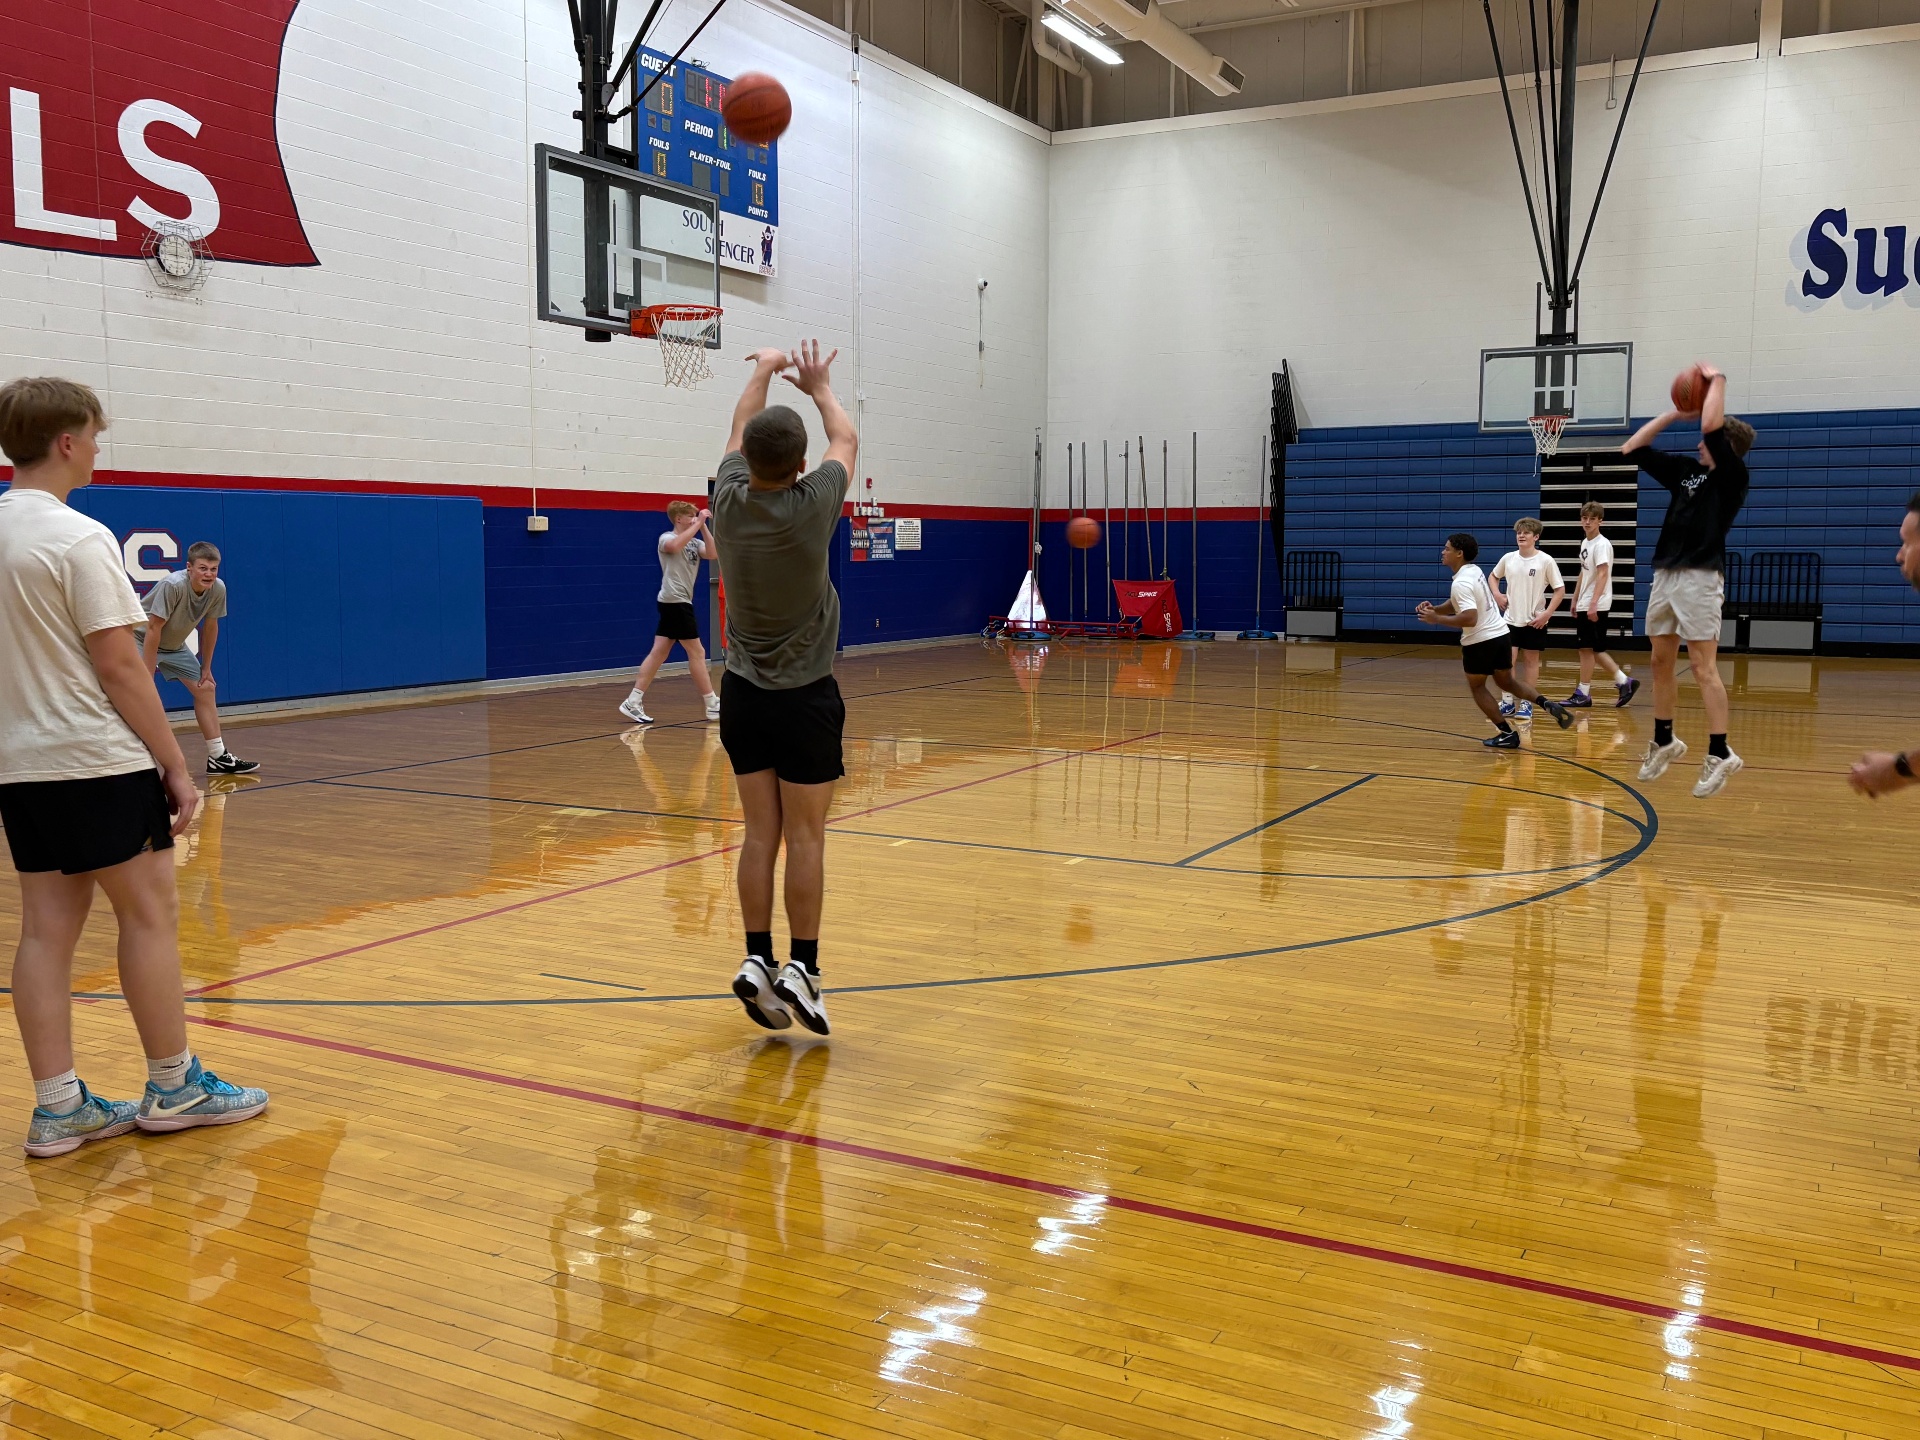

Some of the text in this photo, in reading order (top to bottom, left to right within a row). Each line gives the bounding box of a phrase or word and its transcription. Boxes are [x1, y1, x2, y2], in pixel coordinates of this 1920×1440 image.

[641, 54, 677, 77] GUEST
[685, 120, 714, 139] PERIOD
[649, 137, 670, 151] FOULS
[689, 150, 732, 171] PLAYER-FOUL
[748, 169, 767, 182] FOULS
[748, 206, 768, 219] POINTS
[1801, 206, 1920, 300] Su
